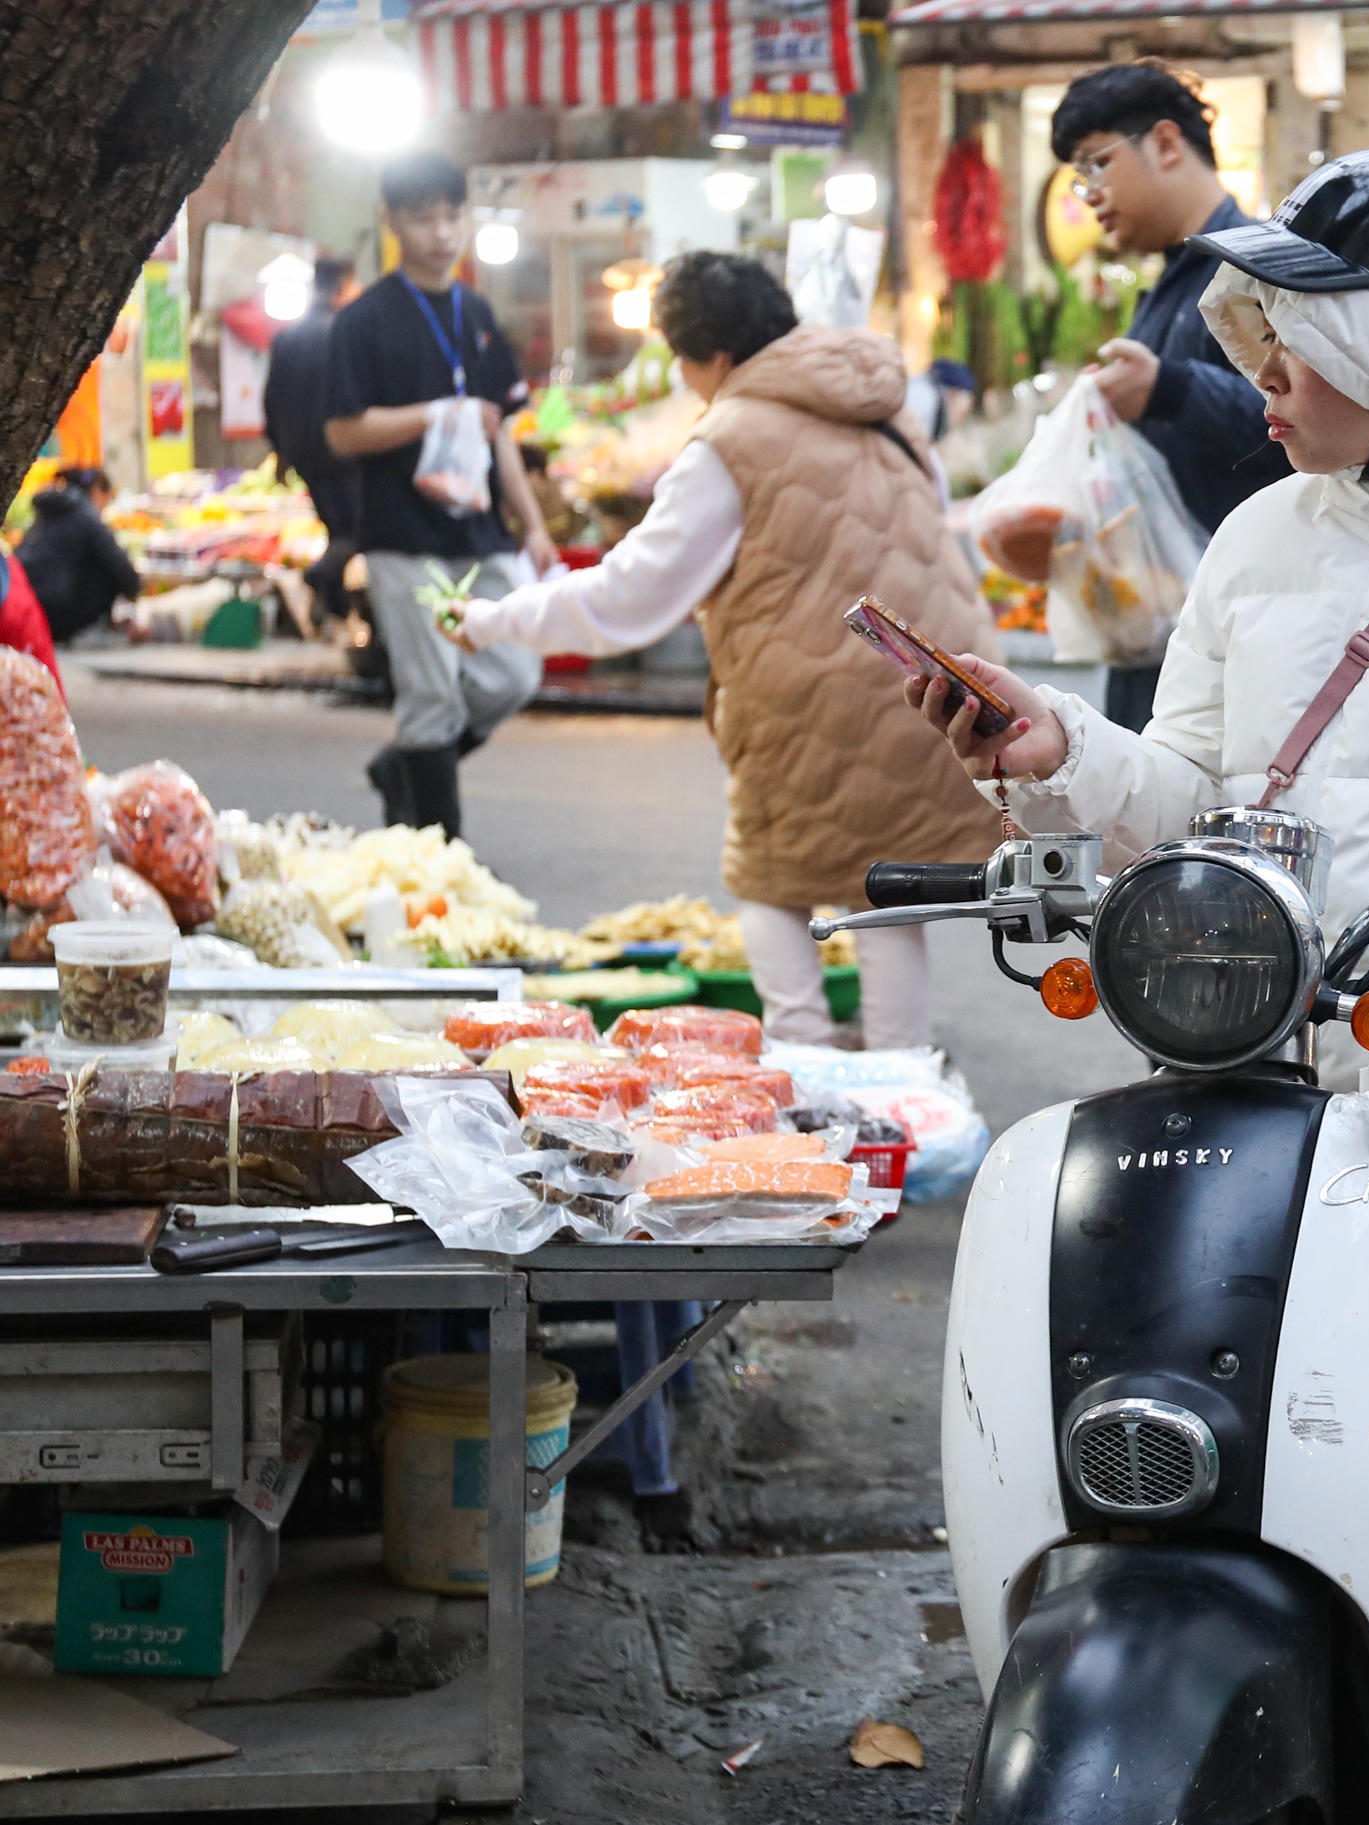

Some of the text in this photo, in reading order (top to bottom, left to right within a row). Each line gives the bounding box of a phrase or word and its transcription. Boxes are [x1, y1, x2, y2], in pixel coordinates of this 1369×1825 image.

[1117, 1147, 1233, 1171] VINSKY
[92, 1533, 187, 1553] LAS PALMS
[108, 1552, 169, 1568] MISSION
